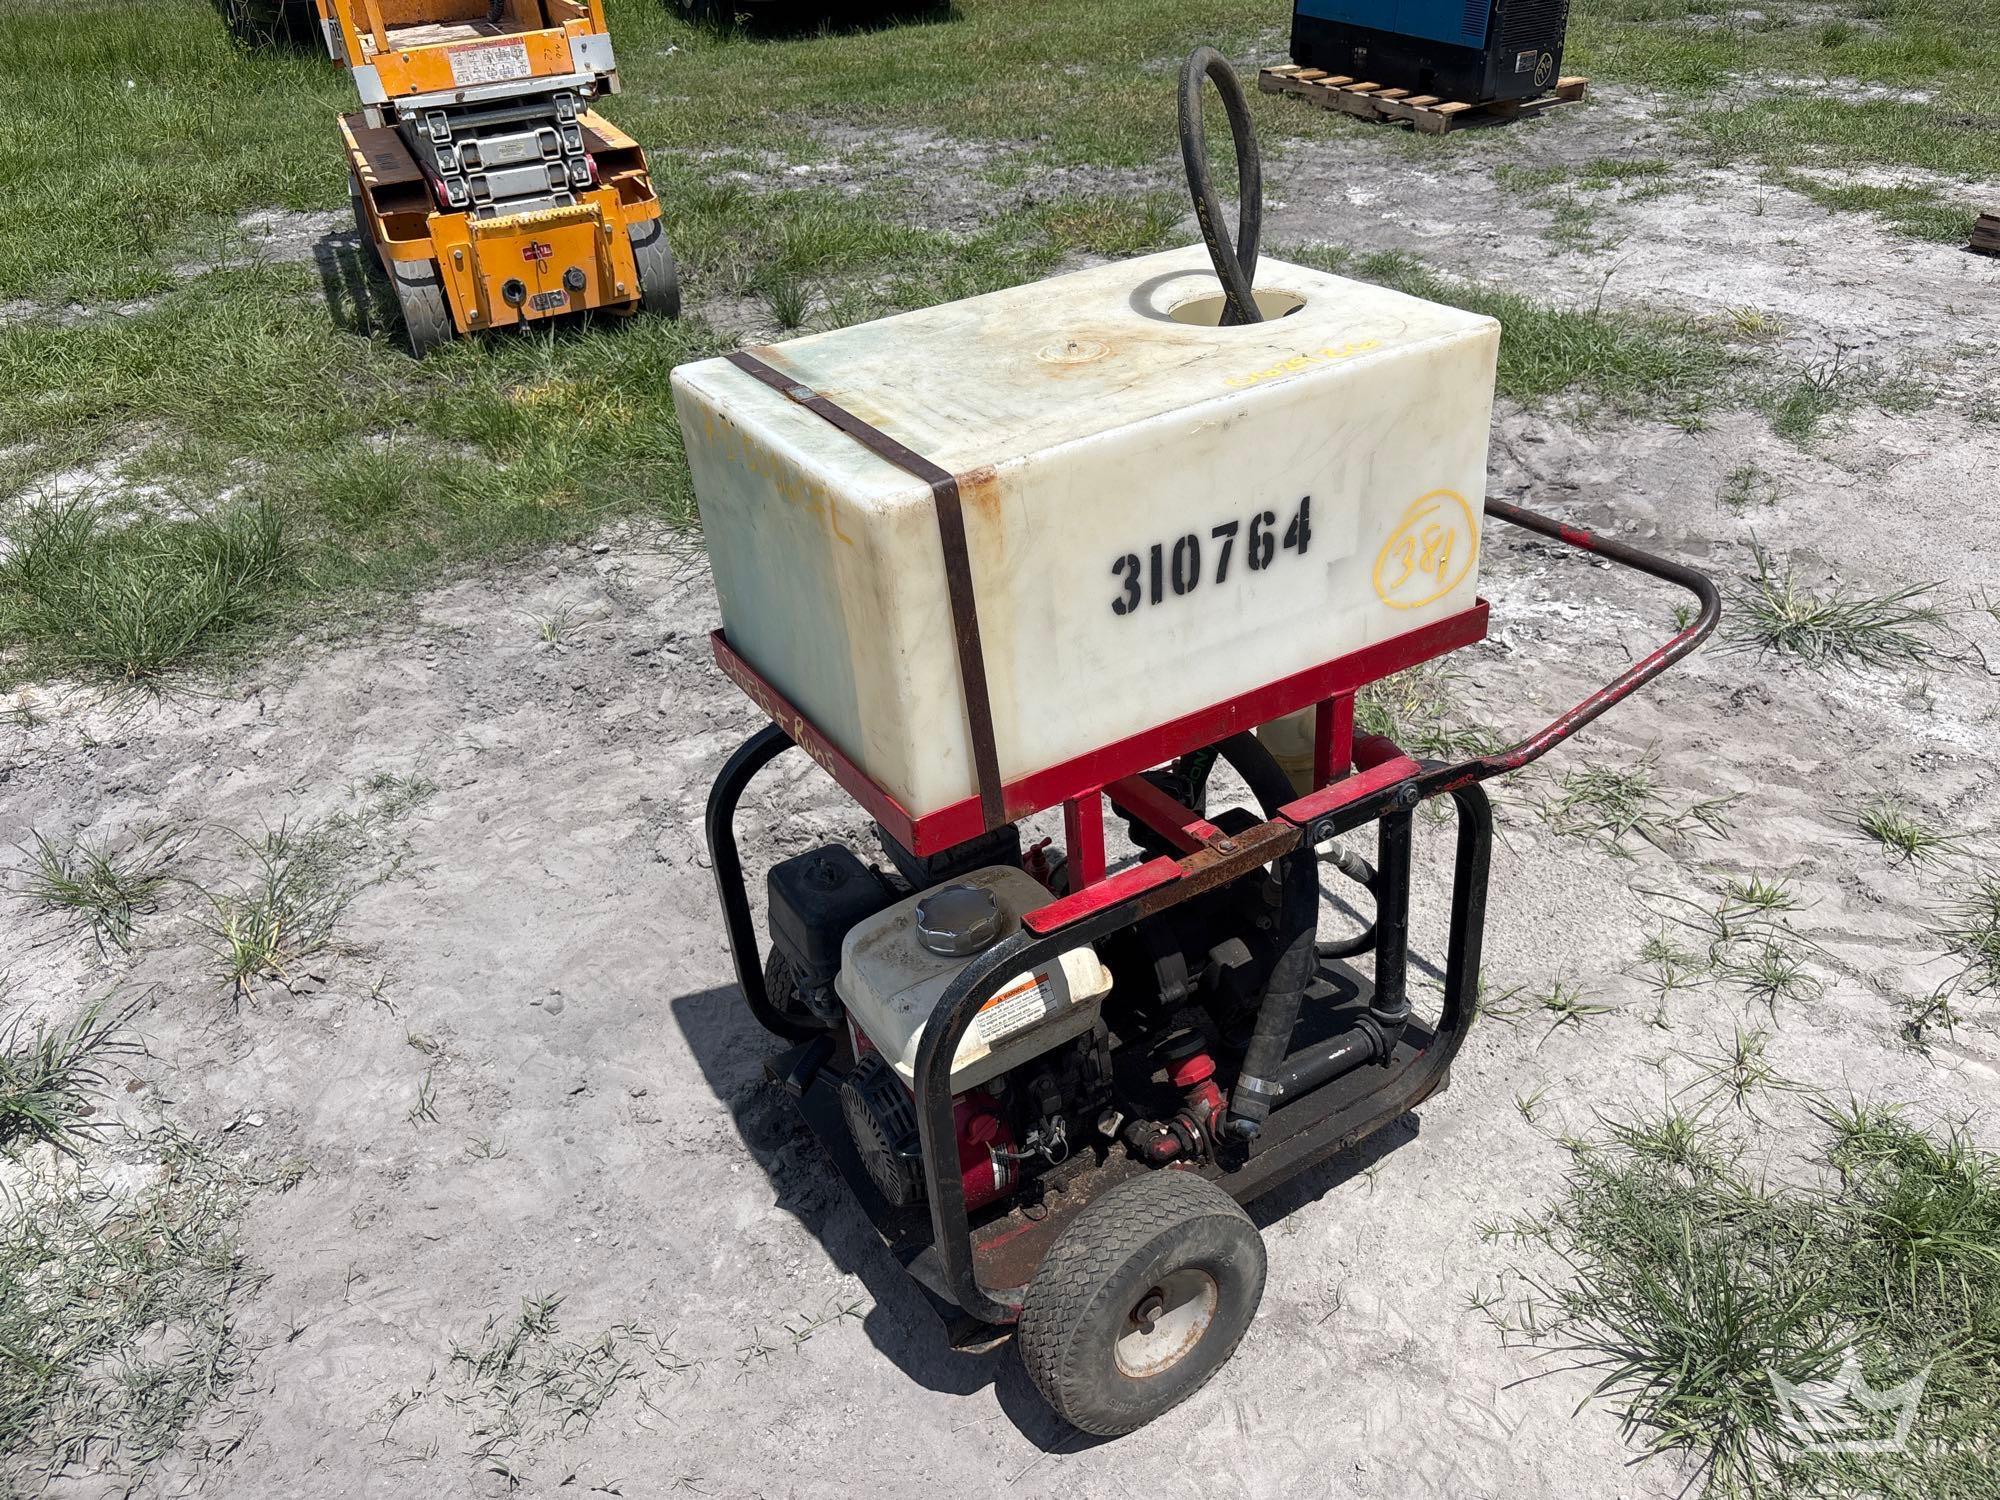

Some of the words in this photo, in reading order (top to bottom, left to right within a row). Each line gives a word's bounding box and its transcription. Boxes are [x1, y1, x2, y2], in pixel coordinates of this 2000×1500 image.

[1111, 496, 1312, 616] 310764
[1390, 523, 1456, 590] 381
[794, 715, 837, 777] Runs
